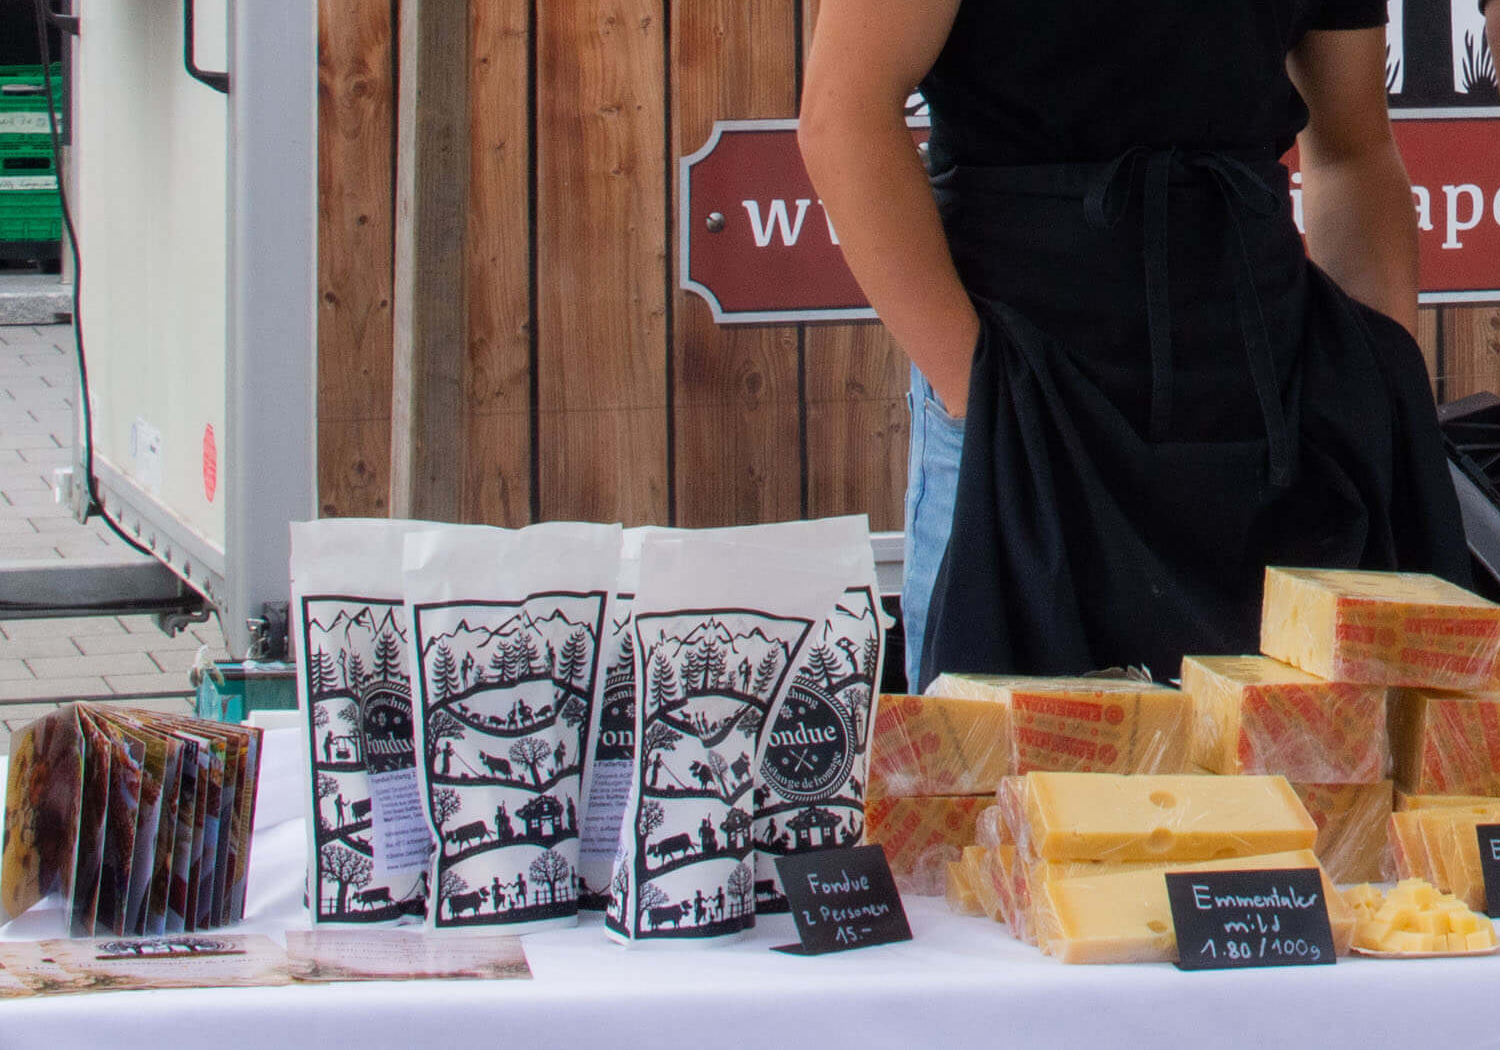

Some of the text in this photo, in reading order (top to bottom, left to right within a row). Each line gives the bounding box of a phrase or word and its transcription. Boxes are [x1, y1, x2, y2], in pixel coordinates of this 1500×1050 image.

[768, 721, 838, 747] ondue
[807, 869, 870, 895] Fondue
[1192, 884, 1318, 910] Emmentaler
[802, 903, 889, 926] 2 Personen
[1223, 913, 1281, 934] mild
